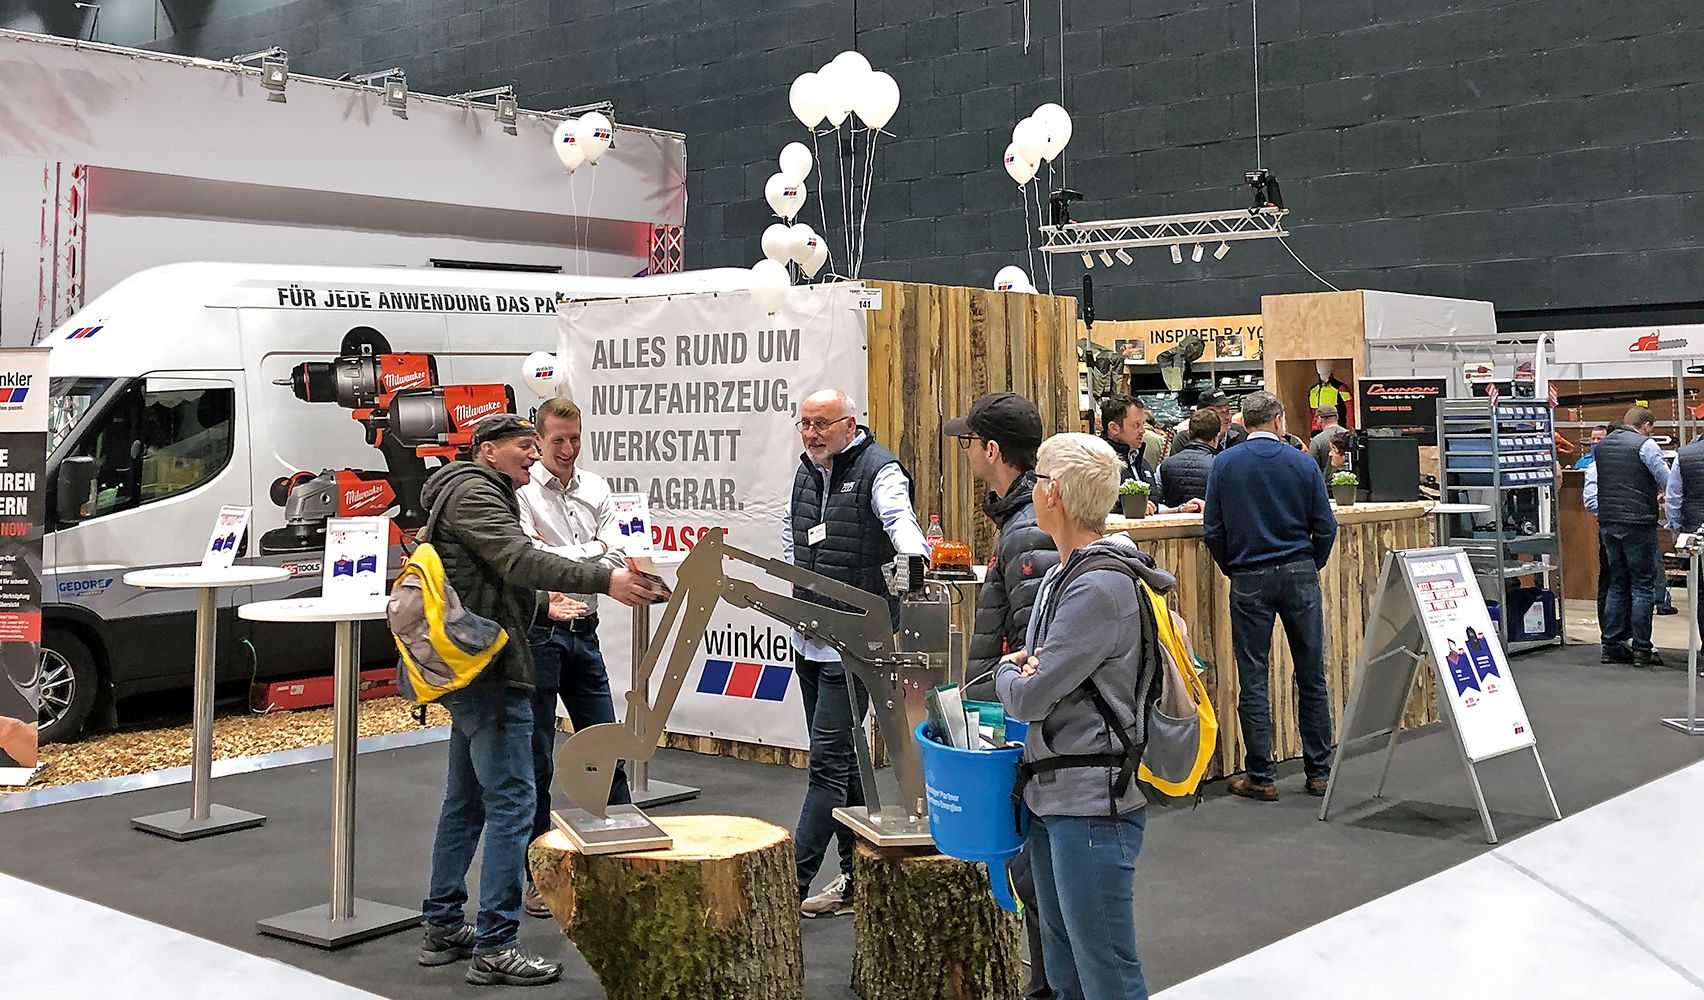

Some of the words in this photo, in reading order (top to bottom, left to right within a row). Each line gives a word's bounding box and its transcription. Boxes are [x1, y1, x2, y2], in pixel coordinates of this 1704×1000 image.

[277, 284, 317, 307] FÜR
[324, 289, 372, 308] JEDE
[378, 291, 491, 312] ANWENDUNG
[495, 295, 530, 313] DAS
[535, 297, 557, 313] PA
[859, 300, 871, 308] 141
[592, 336, 666, 370] ALLES
[676, 332, 748, 367] RUND
[758, 328, 801, 363] UM
[383, 371, 426, 388] Milwaukee
[591, 378, 798, 419] NUTZFAHRZEUG,
[453, 401, 502, 422] Milwaukee
[590, 429, 741, 463] WERKSTATT
[344, 484, 384, 505] Milwaukee
[605, 477, 639, 493] ND
[648, 477, 745, 511] AGRAR.
[650, 525, 729, 551] PAS
[298, 563, 321, 573] TOOLS
[59, 579, 106, 592] GEDORE
